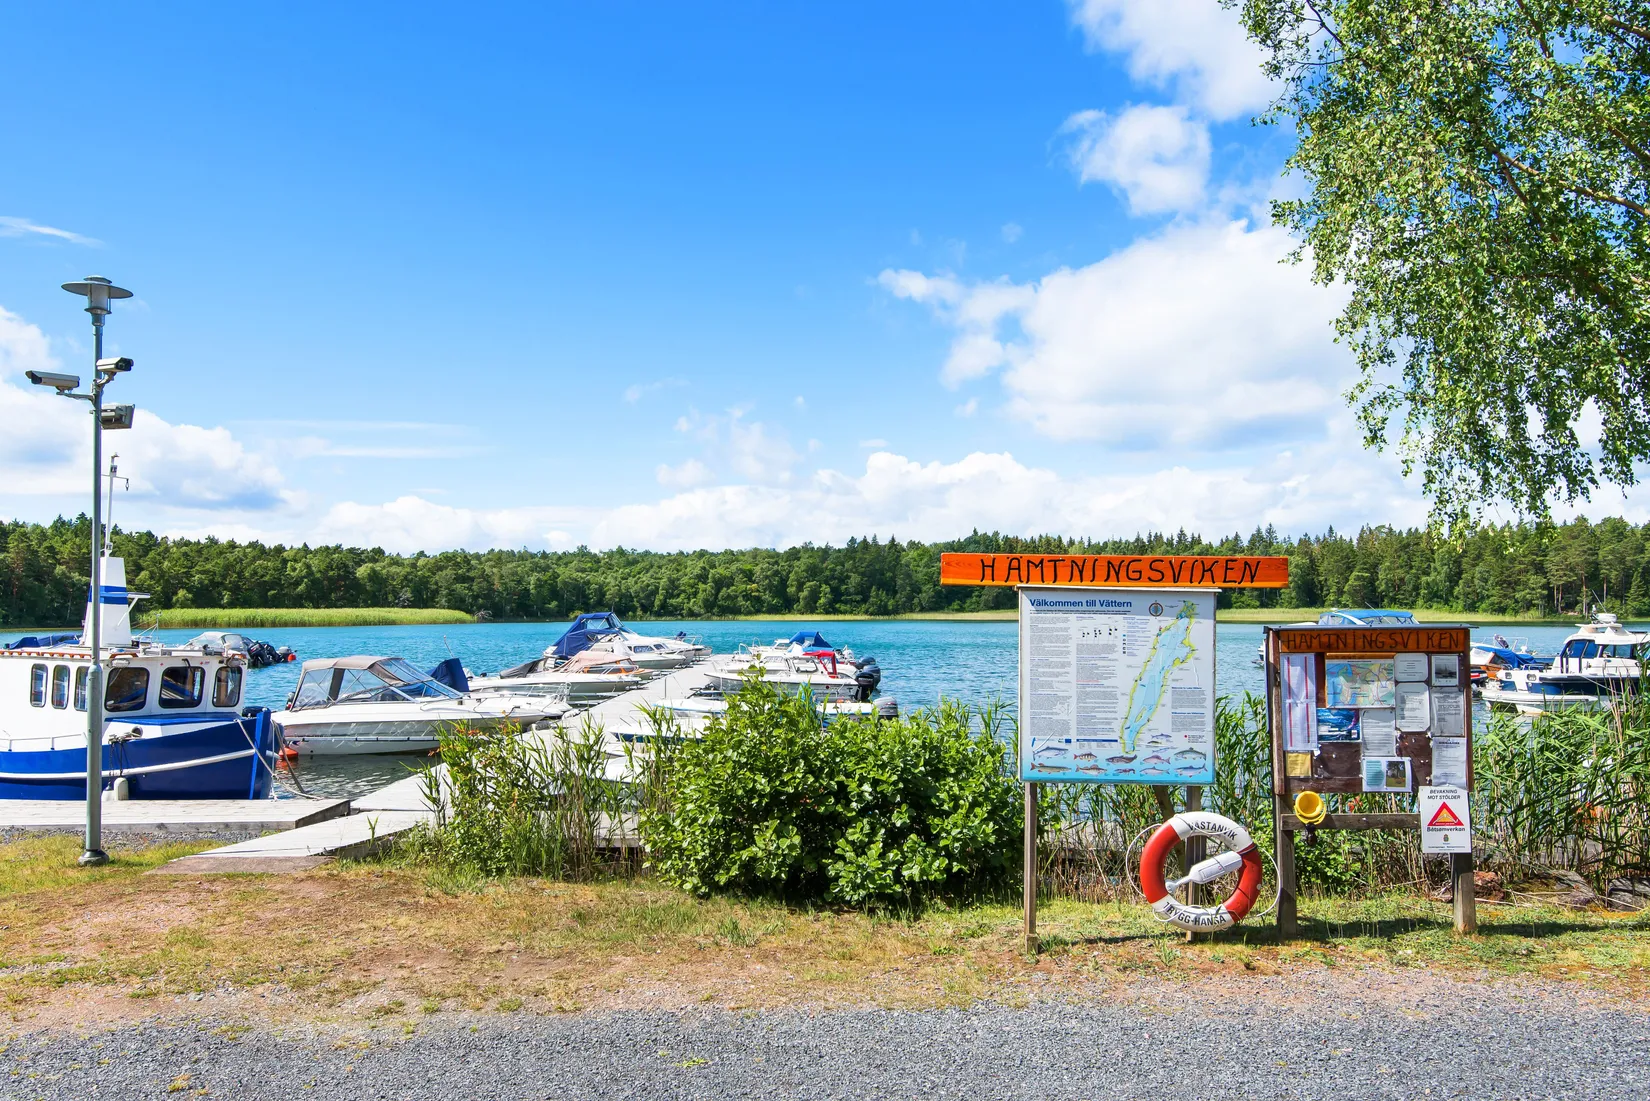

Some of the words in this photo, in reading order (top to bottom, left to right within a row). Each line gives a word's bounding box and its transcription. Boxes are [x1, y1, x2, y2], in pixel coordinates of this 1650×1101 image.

[980, 555, 1261, 584] HÄMTNINGSVIKEN
[1029, 598, 1083, 608] Välkommen
[1085, 599, 1097, 608] till
[1098, 599, 1132, 608] Vättern
